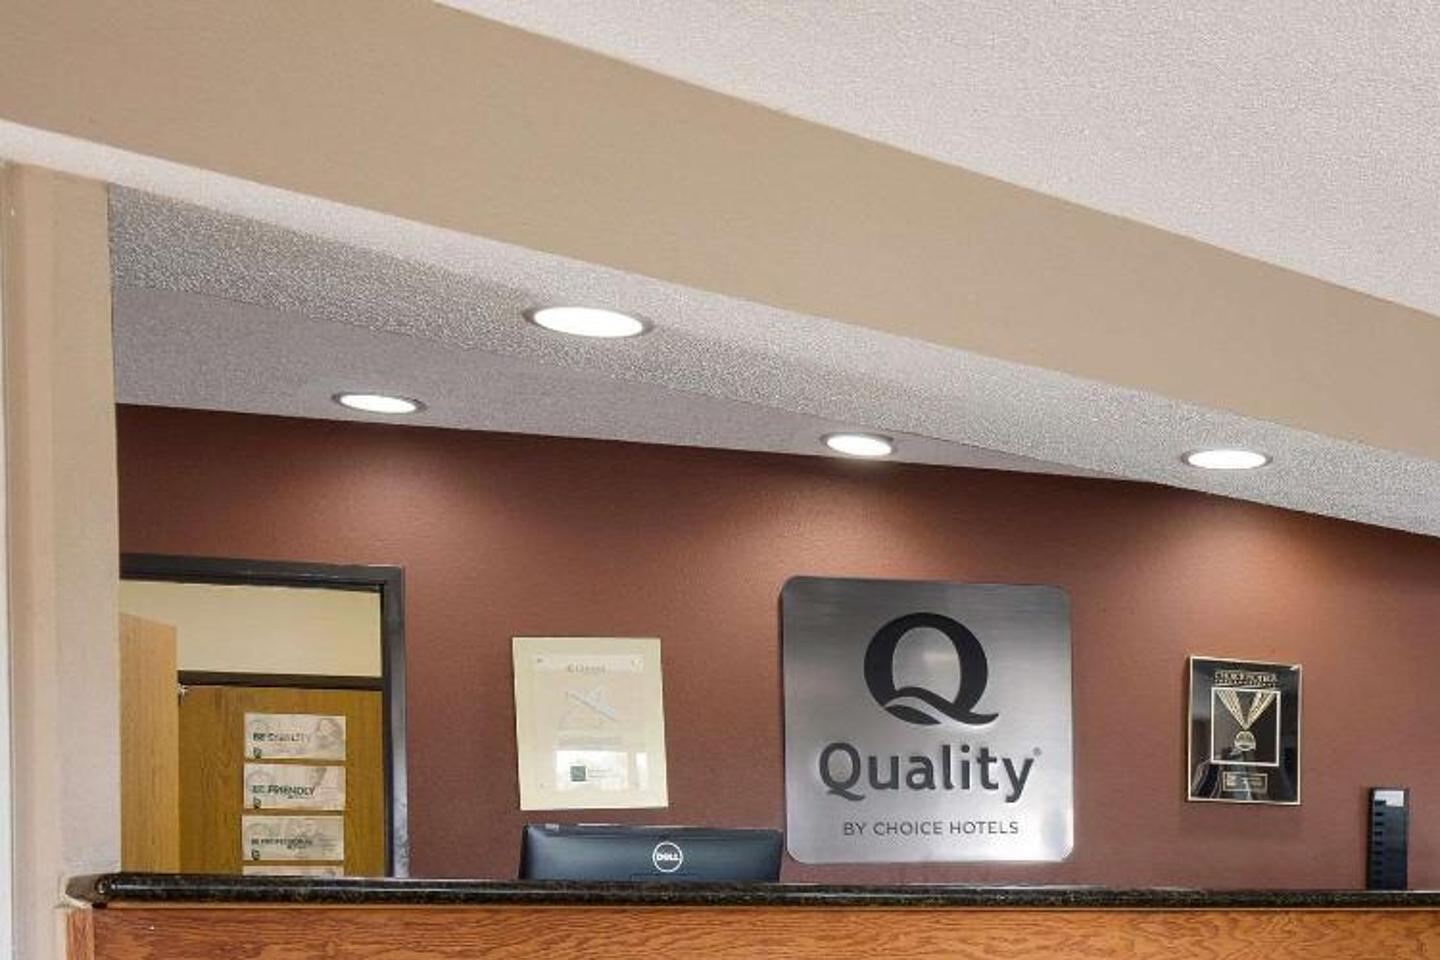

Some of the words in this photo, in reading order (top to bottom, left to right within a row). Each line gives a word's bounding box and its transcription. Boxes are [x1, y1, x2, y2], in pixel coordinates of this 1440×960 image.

[818, 741, 1034, 803] Quality
[844, 823, 866, 836] BY
[873, 822, 943, 836] CHOICE
[950, 822, 1019, 835] HOTELS
[656, 852, 680, 861] DELL
